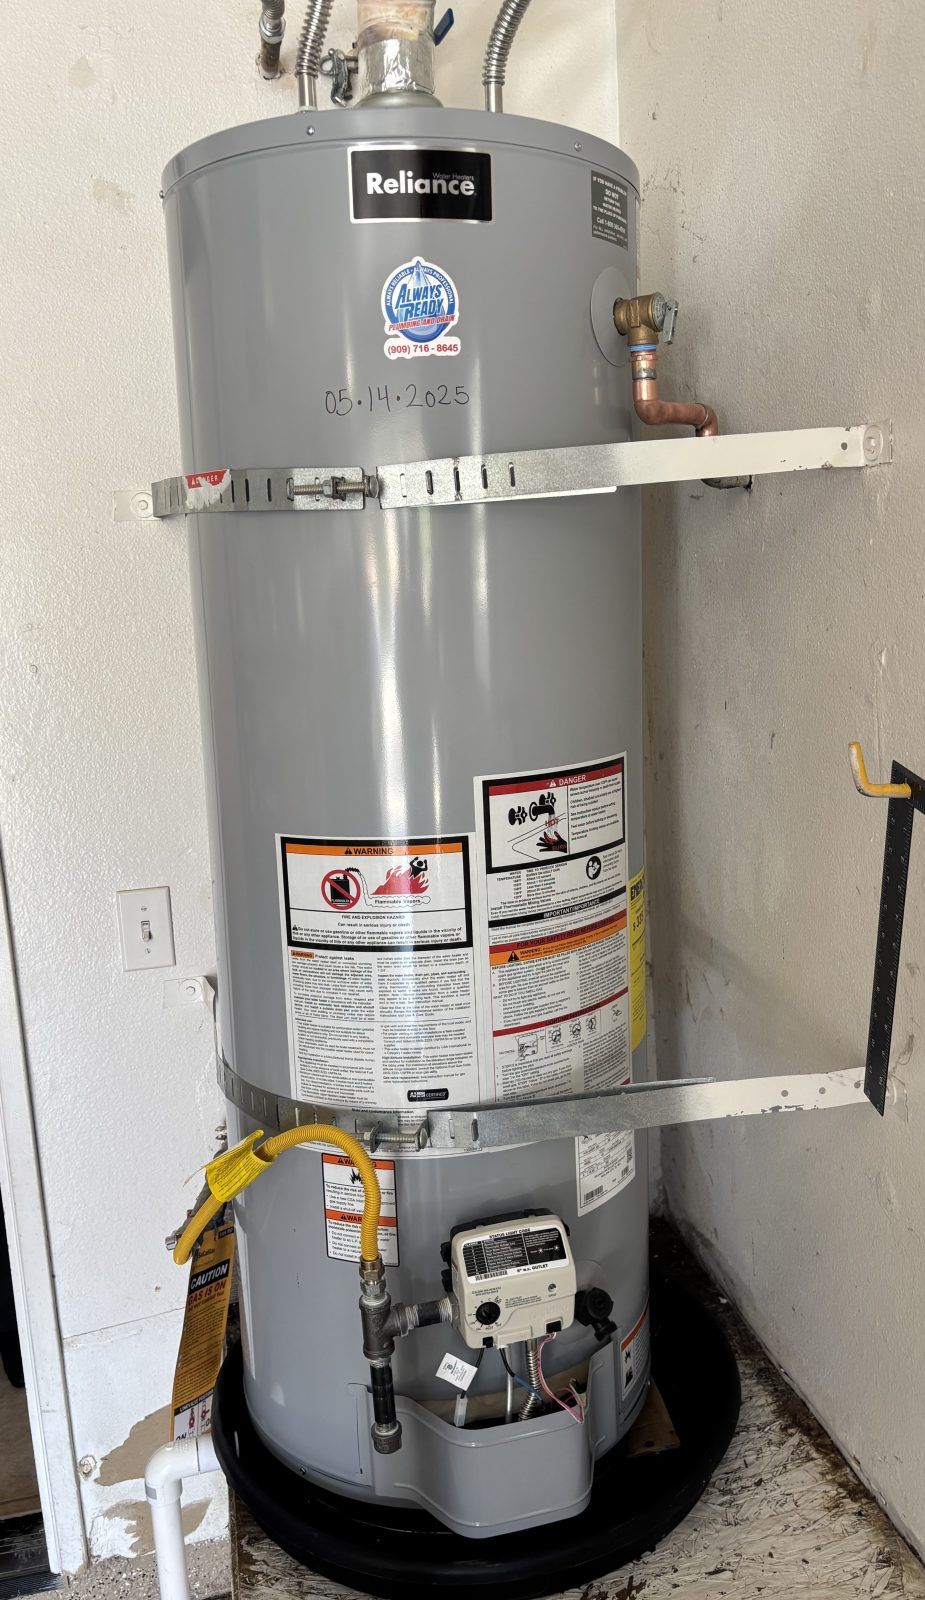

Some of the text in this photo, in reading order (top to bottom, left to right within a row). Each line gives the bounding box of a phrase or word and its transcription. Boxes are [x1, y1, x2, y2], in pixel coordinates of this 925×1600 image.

[366, 170, 475, 196] Reliance
[395, 283, 442, 309] ALWAYS
[400, 298, 444, 321] READY
[422, 317, 436, 326] AND
[388, 345, 410, 355] (909)
[436, 344, 458, 352] 8645
[558, 774, 586, 786] DANGER
[190, 1263, 228, 1290] CAUTION
[214, 1279, 227, 1292] ON
